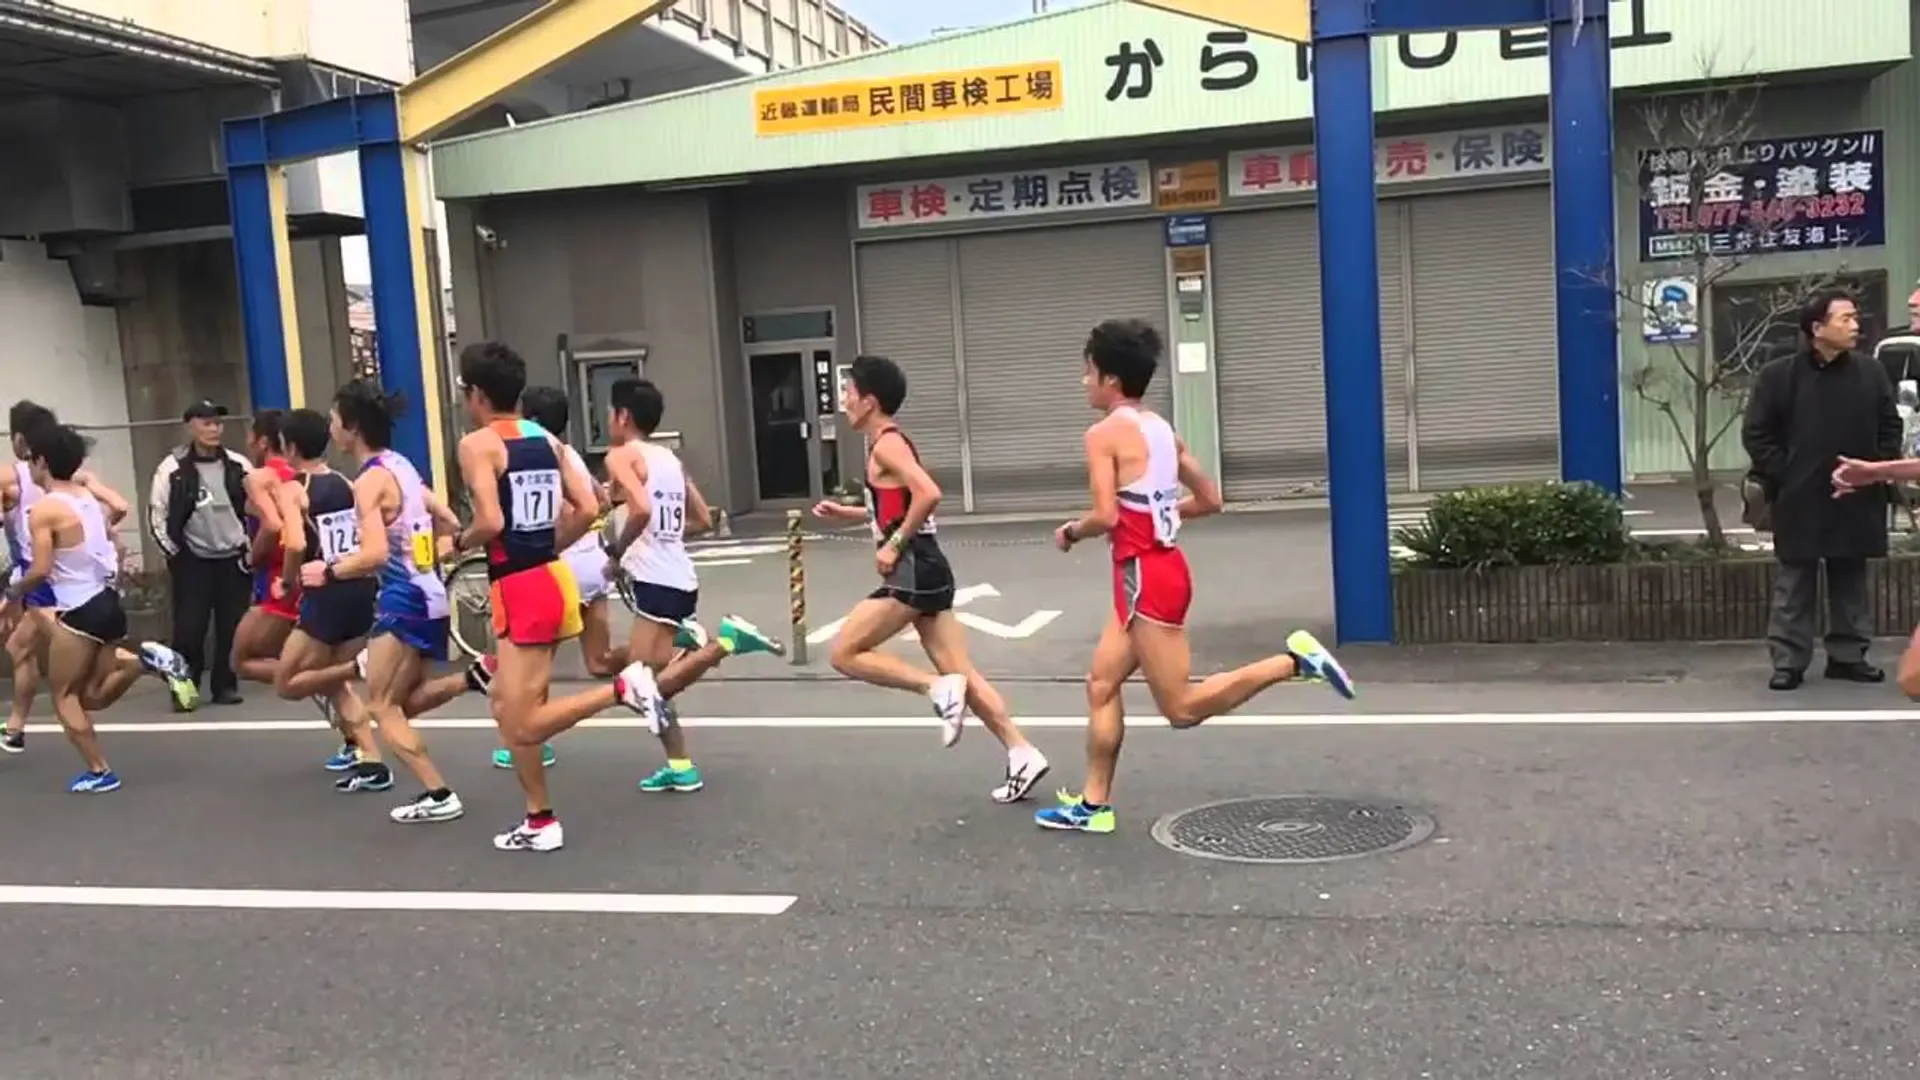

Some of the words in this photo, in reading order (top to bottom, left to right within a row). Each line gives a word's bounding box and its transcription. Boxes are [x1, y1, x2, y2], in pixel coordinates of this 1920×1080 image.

[869, 70, 1052, 116] 民間車検工場
[867, 166, 1140, 222] 車検・定期点検
[523, 489, 553, 522] 171
[660, 504, 682, 531] 119
